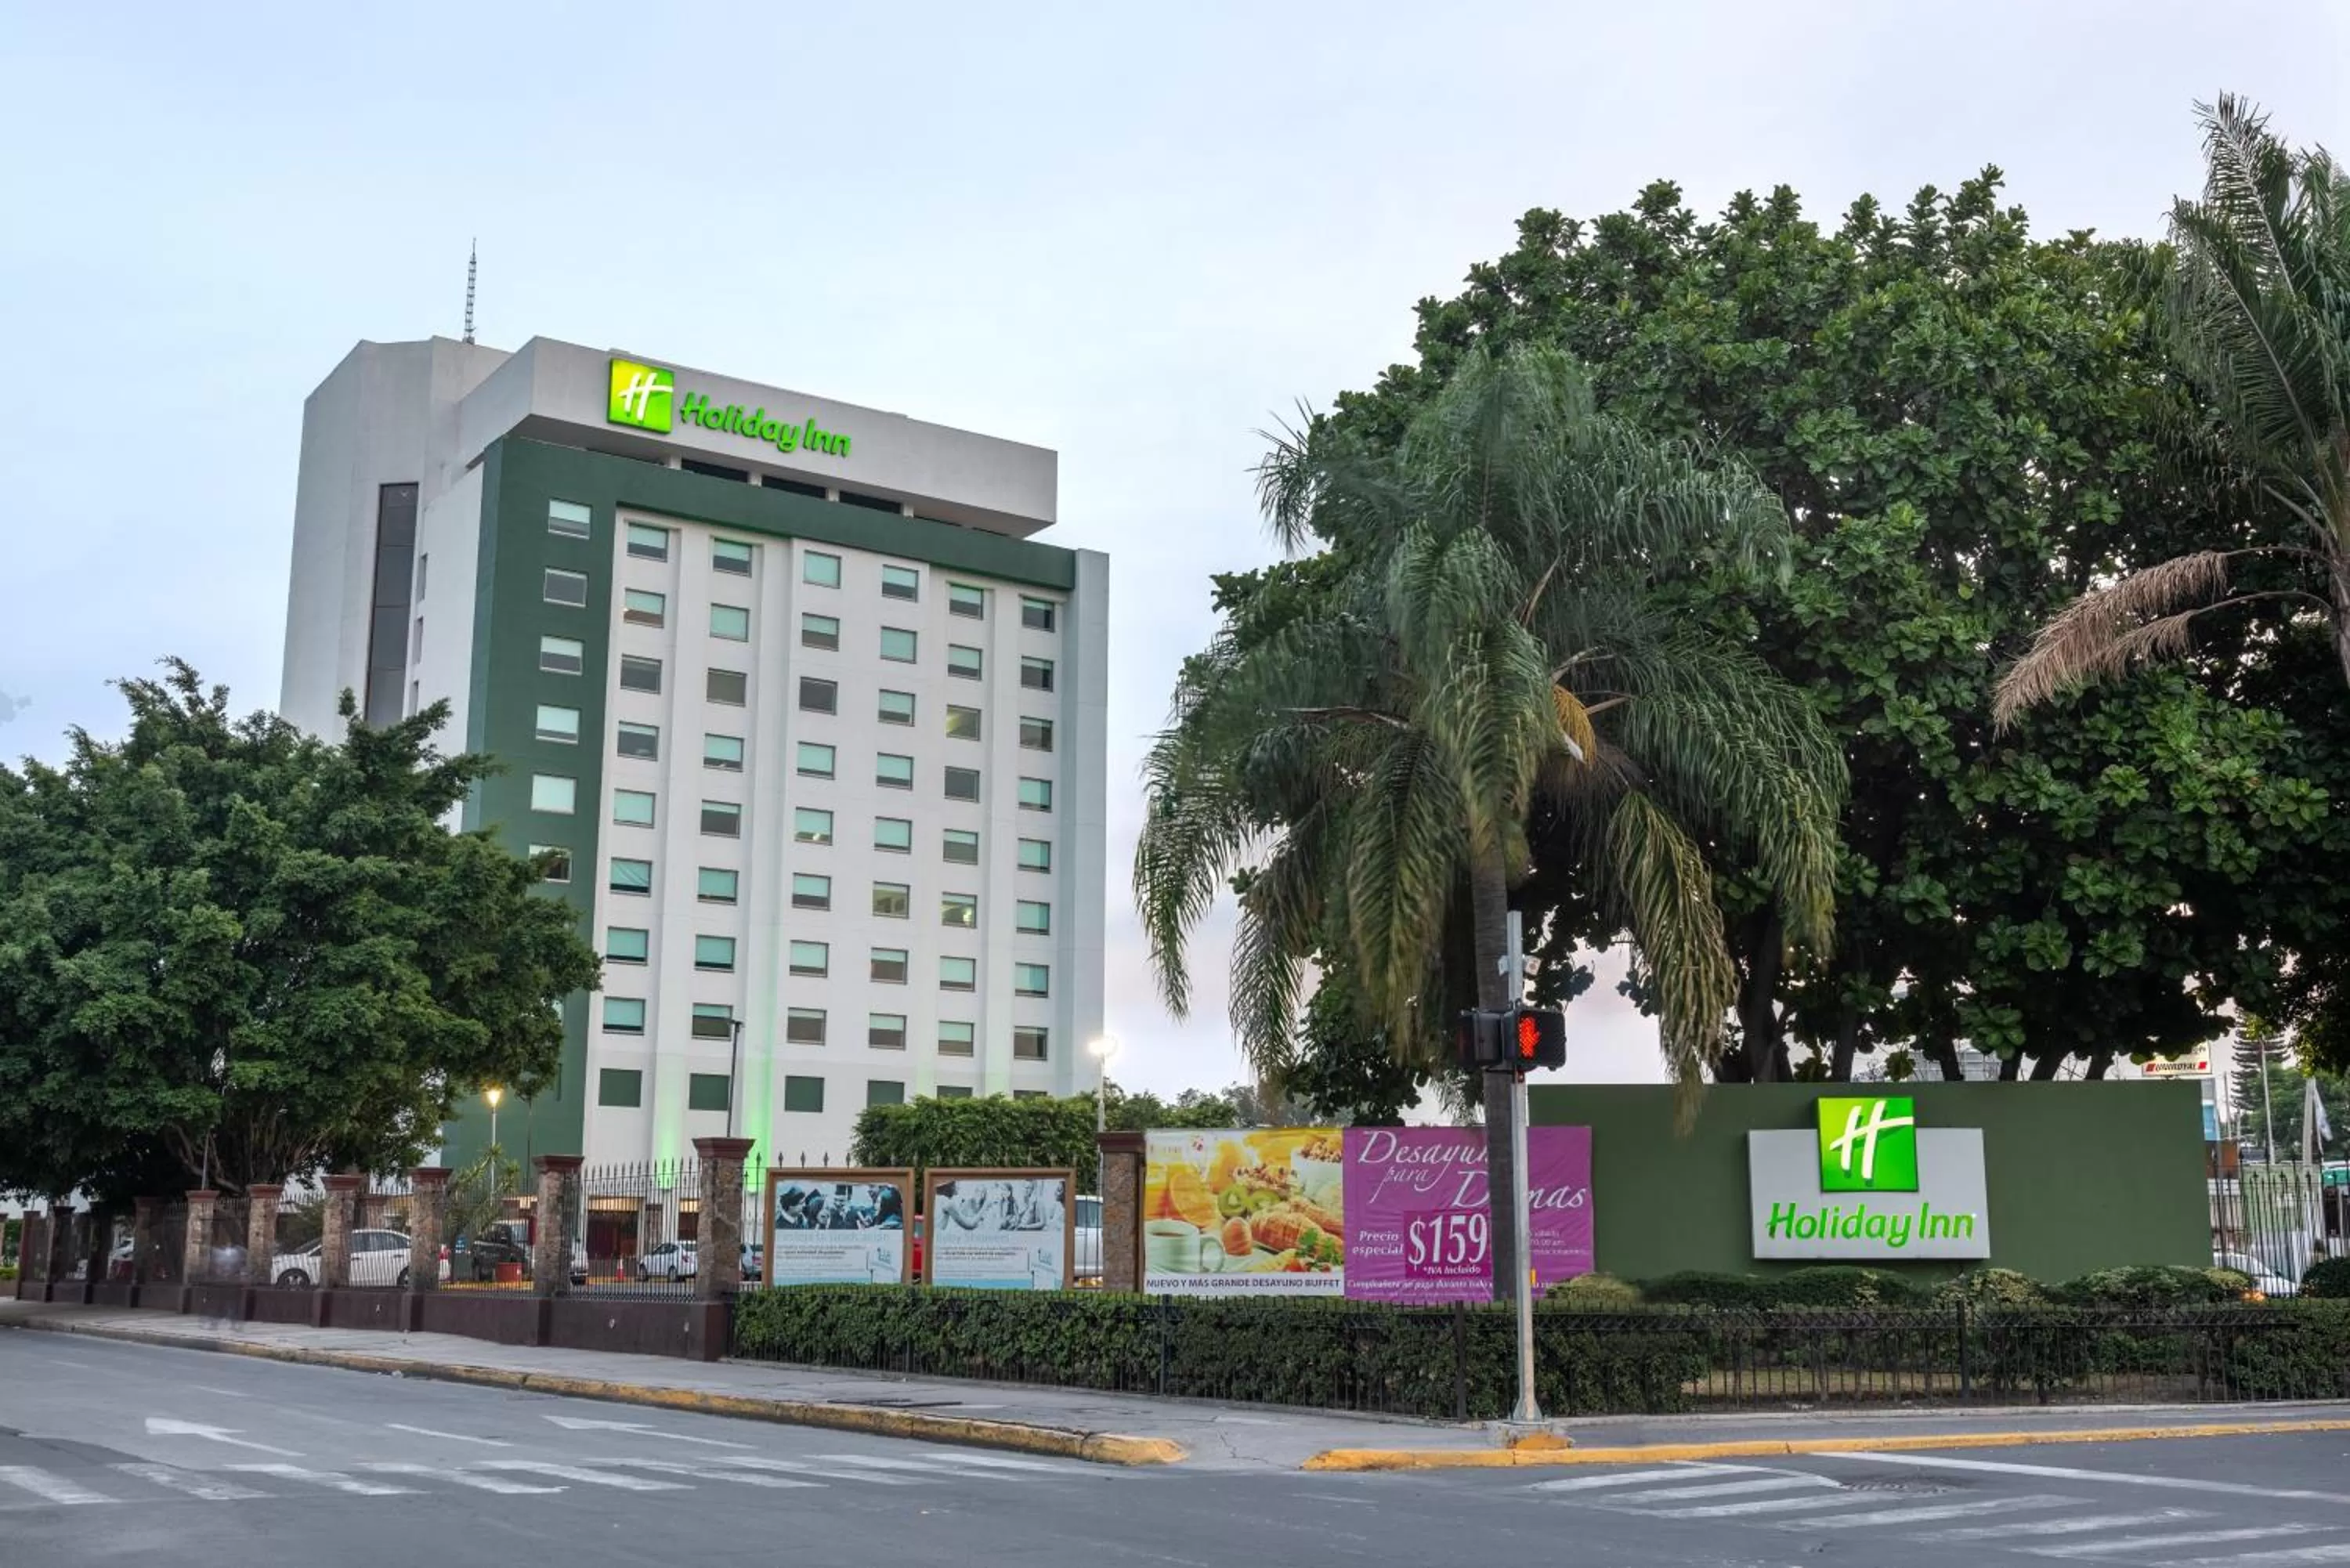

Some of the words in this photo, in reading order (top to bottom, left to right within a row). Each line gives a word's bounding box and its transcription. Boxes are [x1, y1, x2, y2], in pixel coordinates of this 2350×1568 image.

[679, 392, 801, 453] Holiday
[802, 418, 851, 457] Inn
[1369, 1164, 1433, 1204] para
[1452, 1170, 1586, 1209] Dmas
[1359, 1230, 1398, 1241] Precio
[1407, 1212, 1488, 1271] $159
[1766, 1202, 1912, 1248] Holiday
[1919, 1202, 1975, 1239] Inn
[1352, 1244, 1404, 1257] especial
[1146, 1278, 1179, 1288] NUEVO
[1180, 1279, 1187, 1288] Y
[1189, 1277, 1210, 1288] MÁS
[1211, 1278, 1250, 1287] GRANDE
[1253, 1278, 1303, 1287] DESAYUNO
[1305, 1278, 1340, 1287] BUFFET
